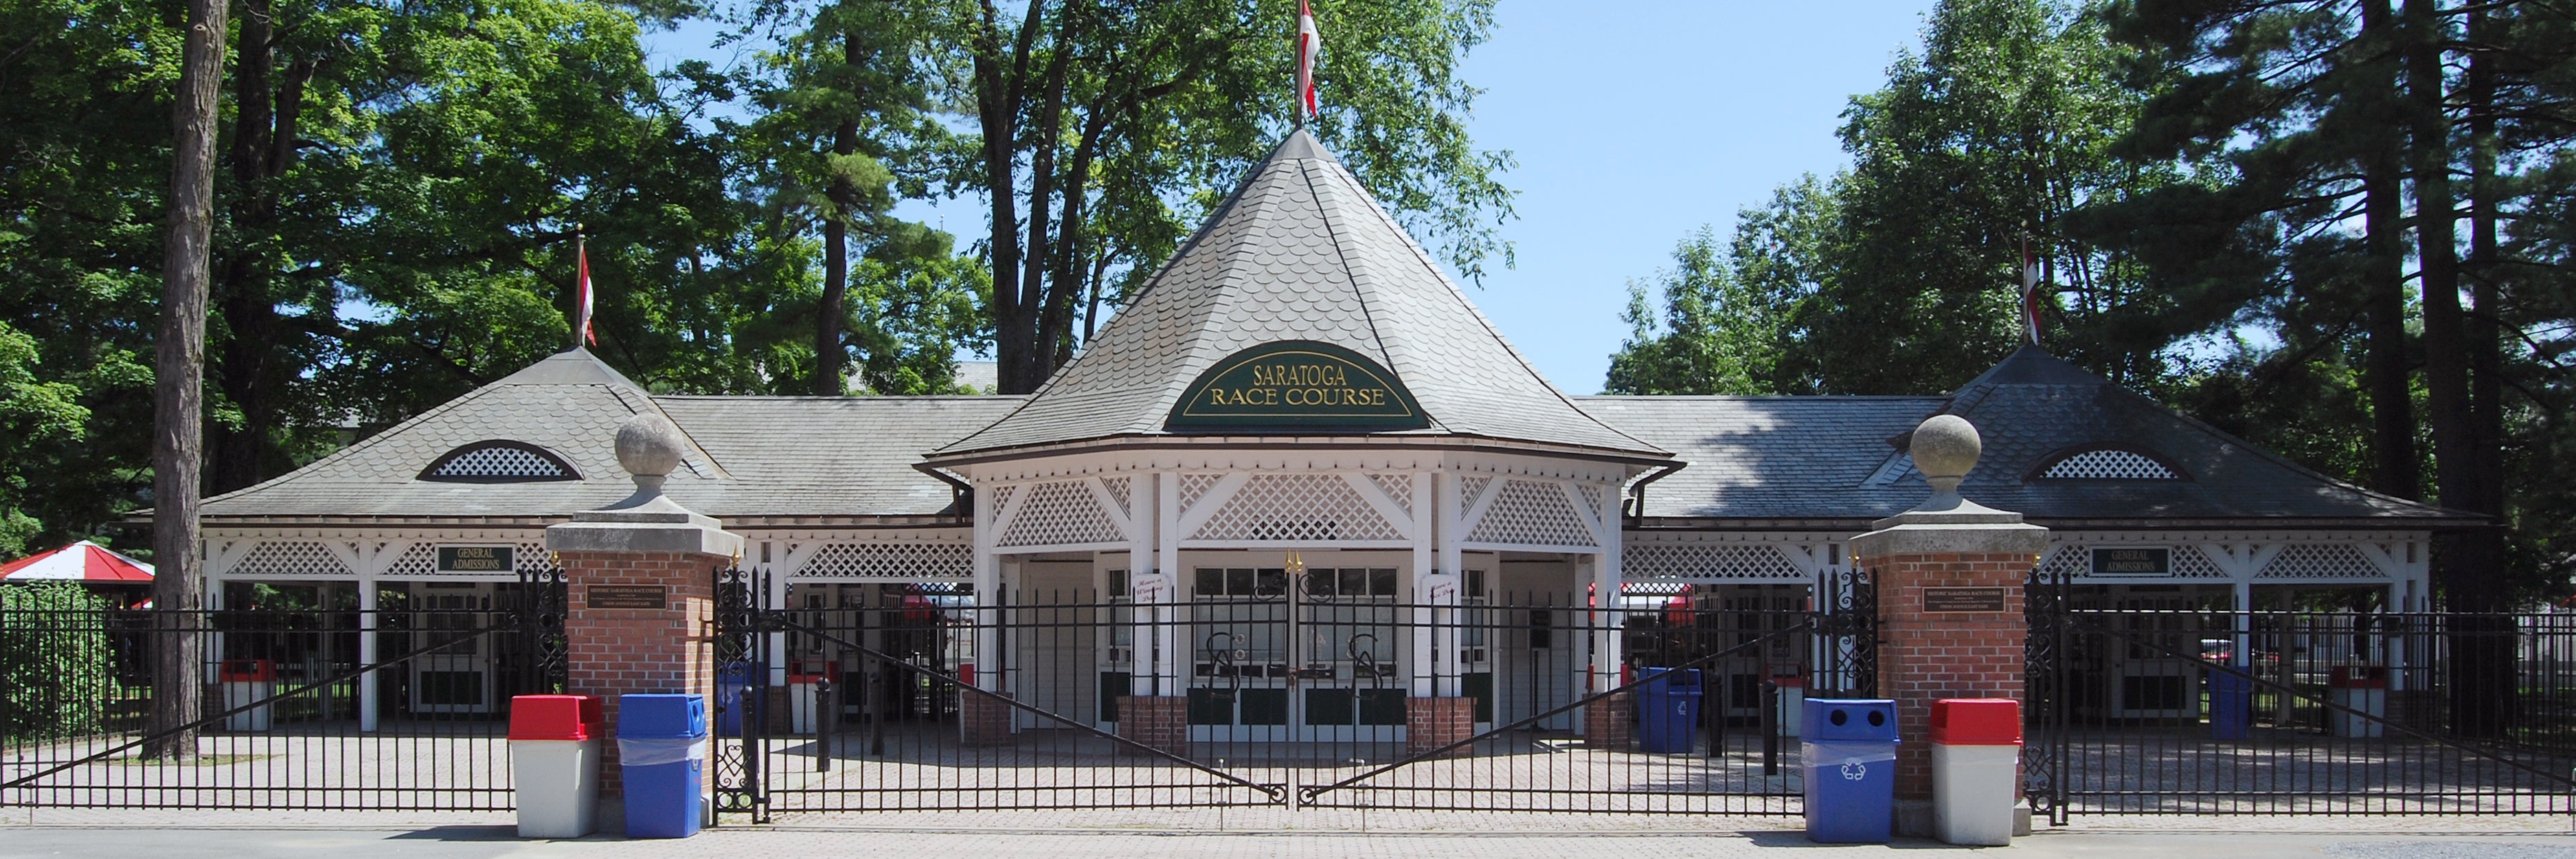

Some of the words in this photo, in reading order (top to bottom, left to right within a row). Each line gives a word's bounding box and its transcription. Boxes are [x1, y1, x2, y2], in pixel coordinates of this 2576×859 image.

[1254, 365, 1346, 387] SARATOGA
[1210, 388, 1278, 405] RACE
[1285, 388, 1385, 405] COURSE
[457, 548, 494, 558] GENERAL
[2111, 550, 2149, 560] GENERAL
[453, 559, 500, 569] ADMISSIONS
[2107, 561, 2155, 572] ADMISSIONS
[1137, 586, 1163, 595] Winnng
